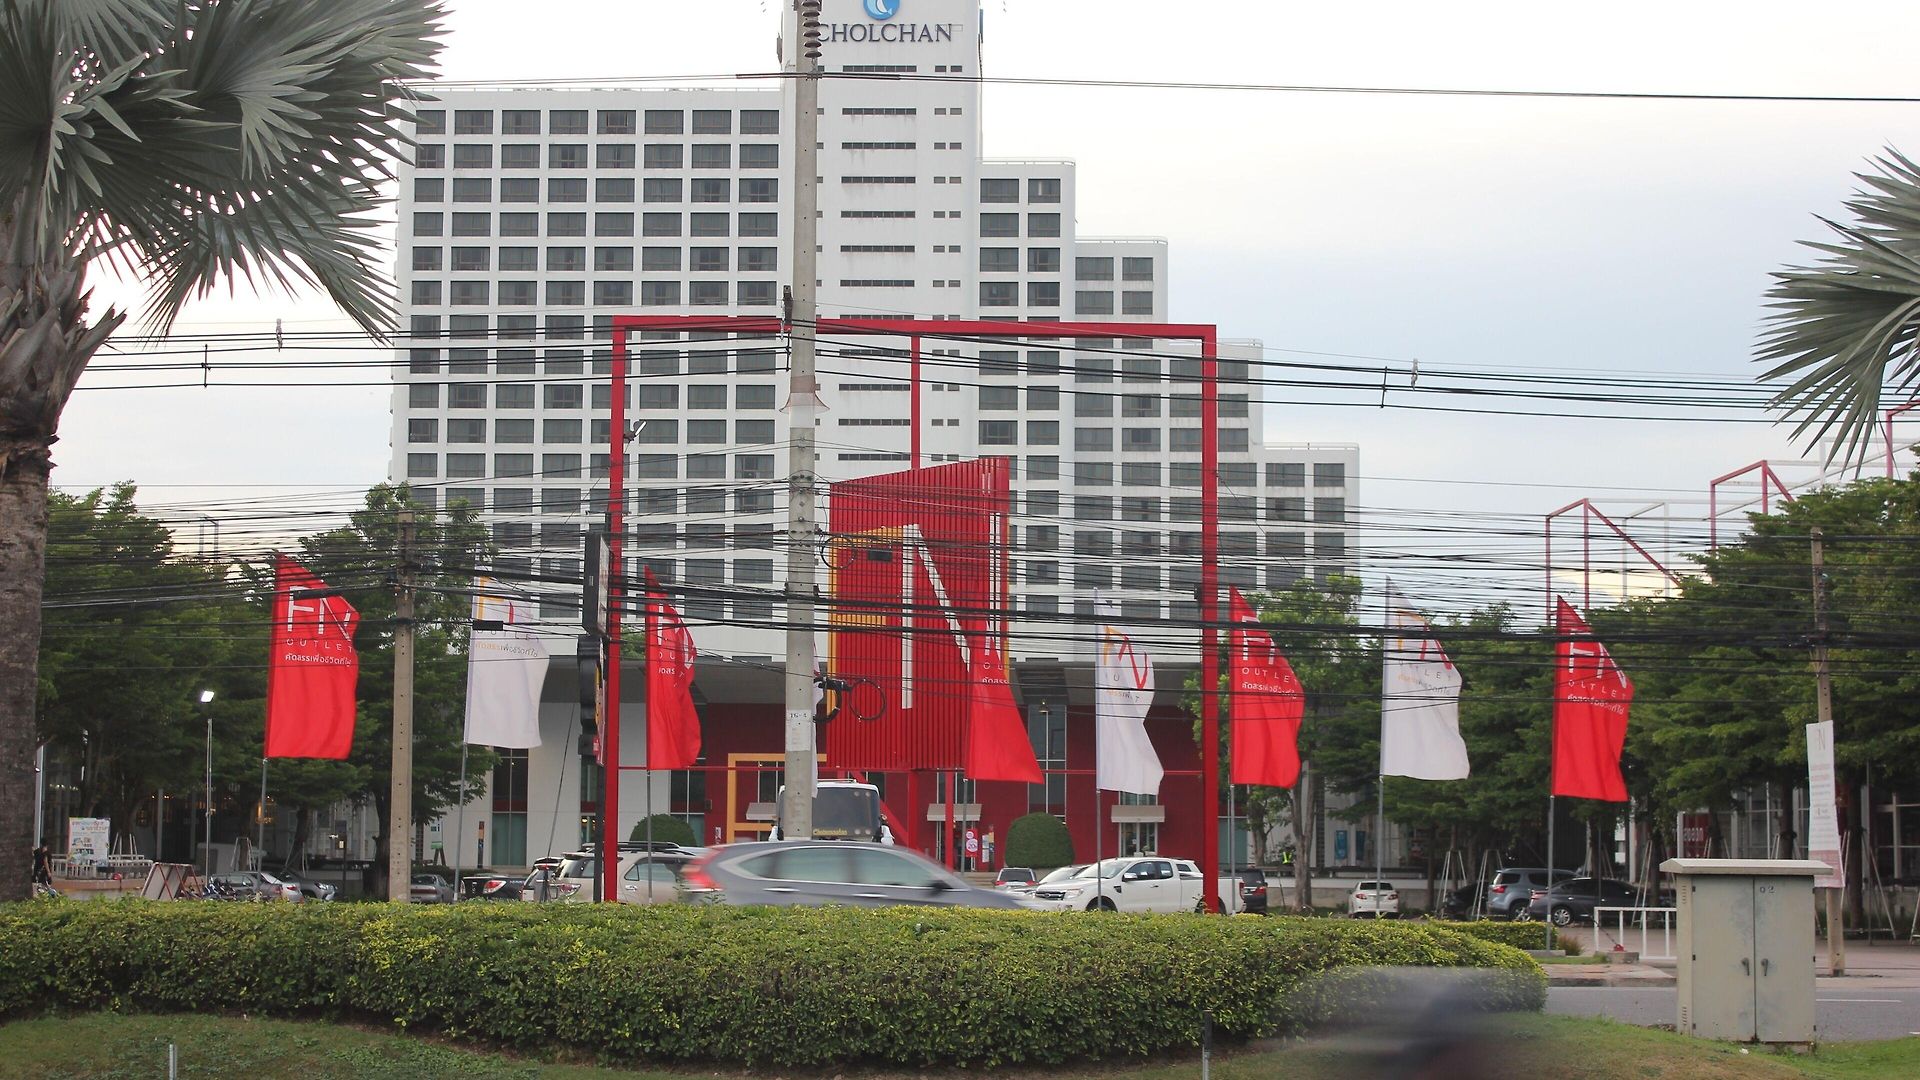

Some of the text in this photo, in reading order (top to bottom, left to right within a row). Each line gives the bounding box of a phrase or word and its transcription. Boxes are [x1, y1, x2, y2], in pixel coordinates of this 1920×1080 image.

[817, 23, 952, 43] CHOLCHAN
[286, 638, 353, 653] OUTLET
[1241, 667, 1297, 686] OUTLET
